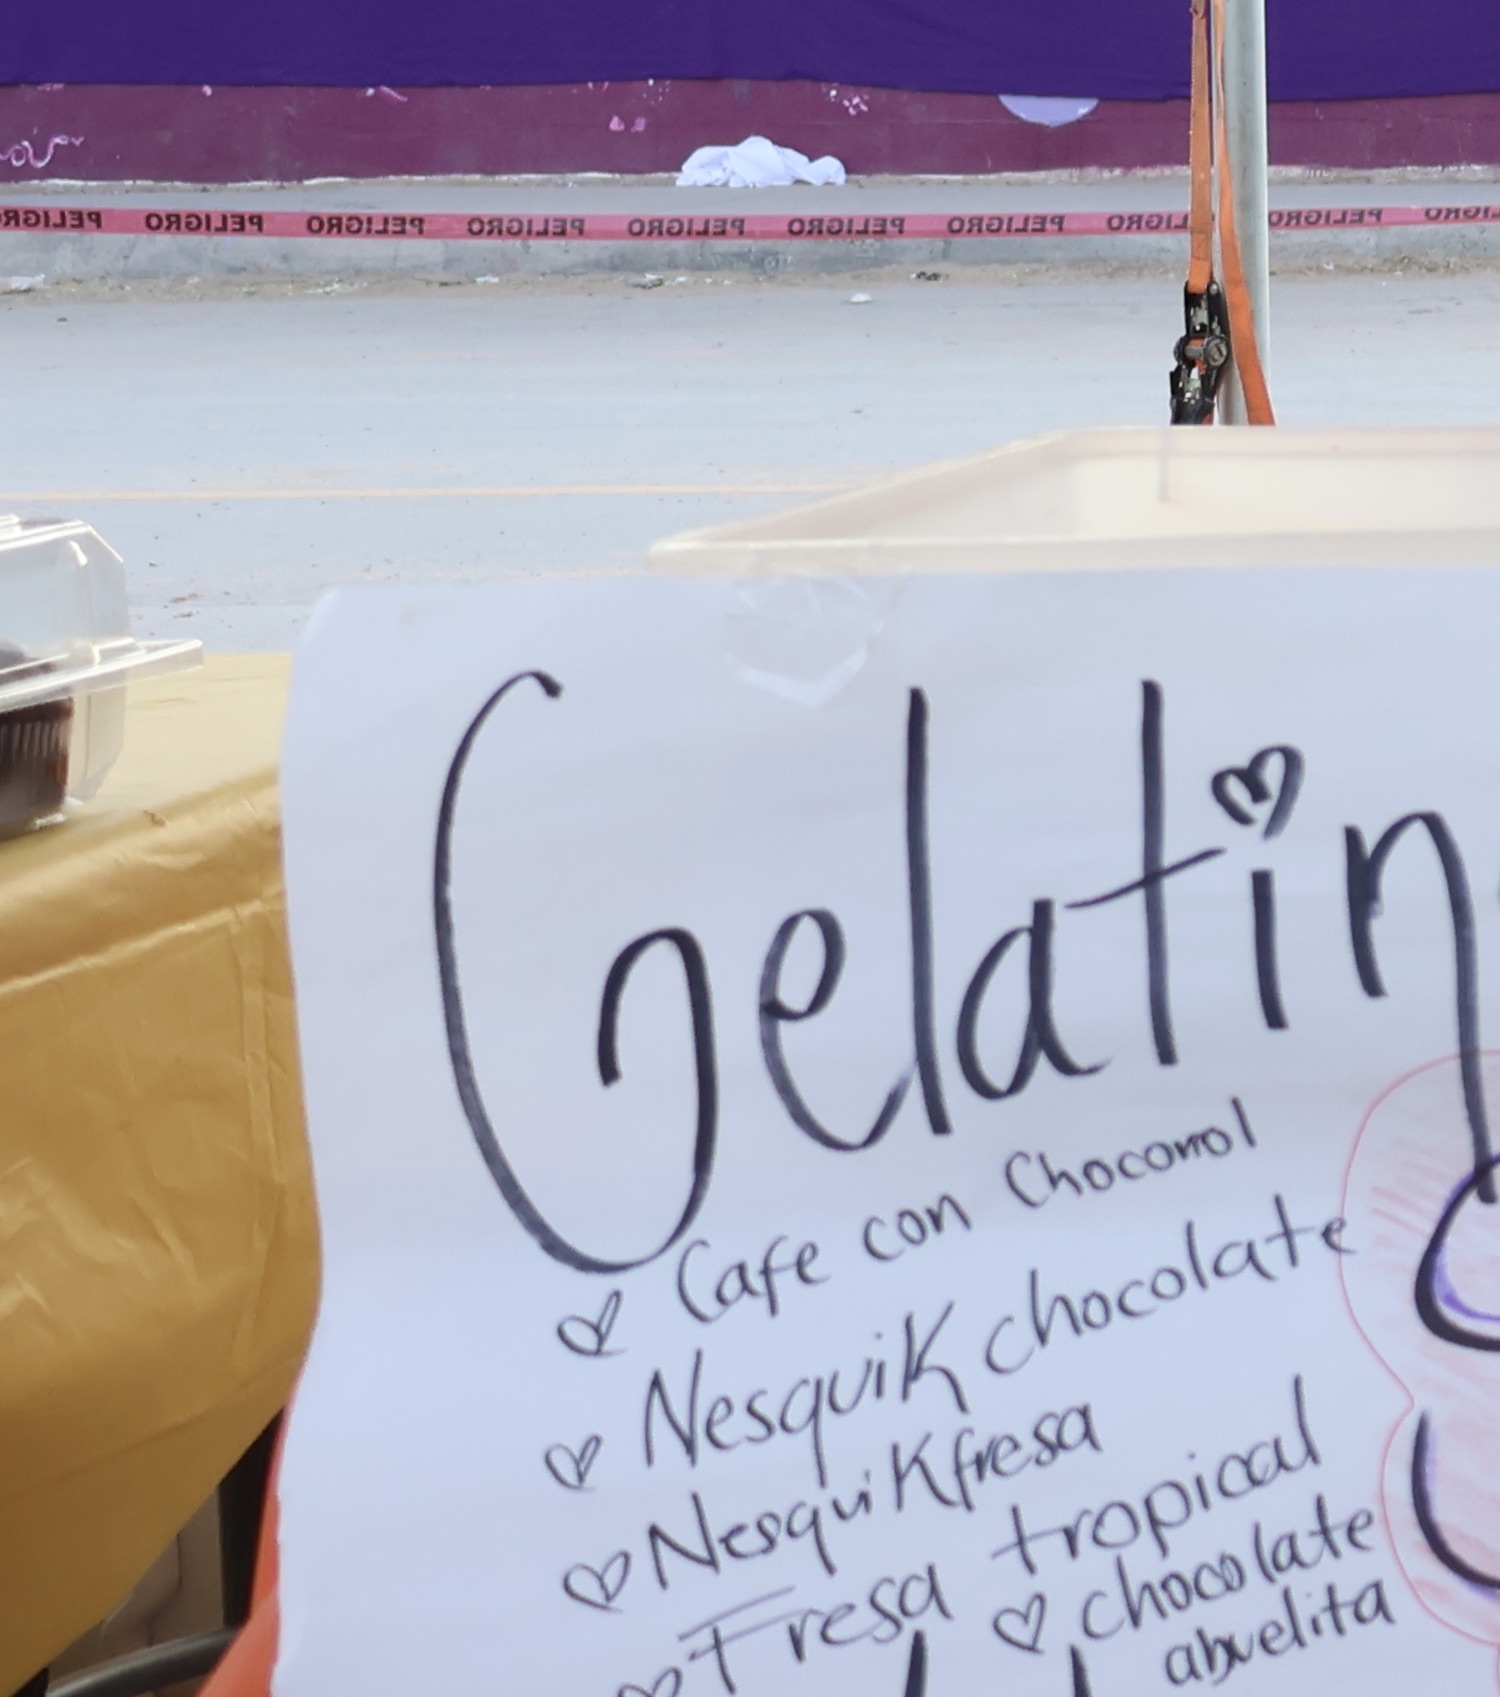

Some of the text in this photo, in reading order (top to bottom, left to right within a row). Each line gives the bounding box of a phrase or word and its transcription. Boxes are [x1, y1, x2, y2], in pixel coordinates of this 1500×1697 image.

[676, 1236, 830, 1324] Cafe
[862, 1191, 973, 1263] con
[984, 1193, 1360, 1377] chocolate
[677, 1373, 1324, 1695] Fresa tropical
[1080, 1493, 1377, 1644] chocolate
[1164, 1578, 1397, 1688] abuelita
